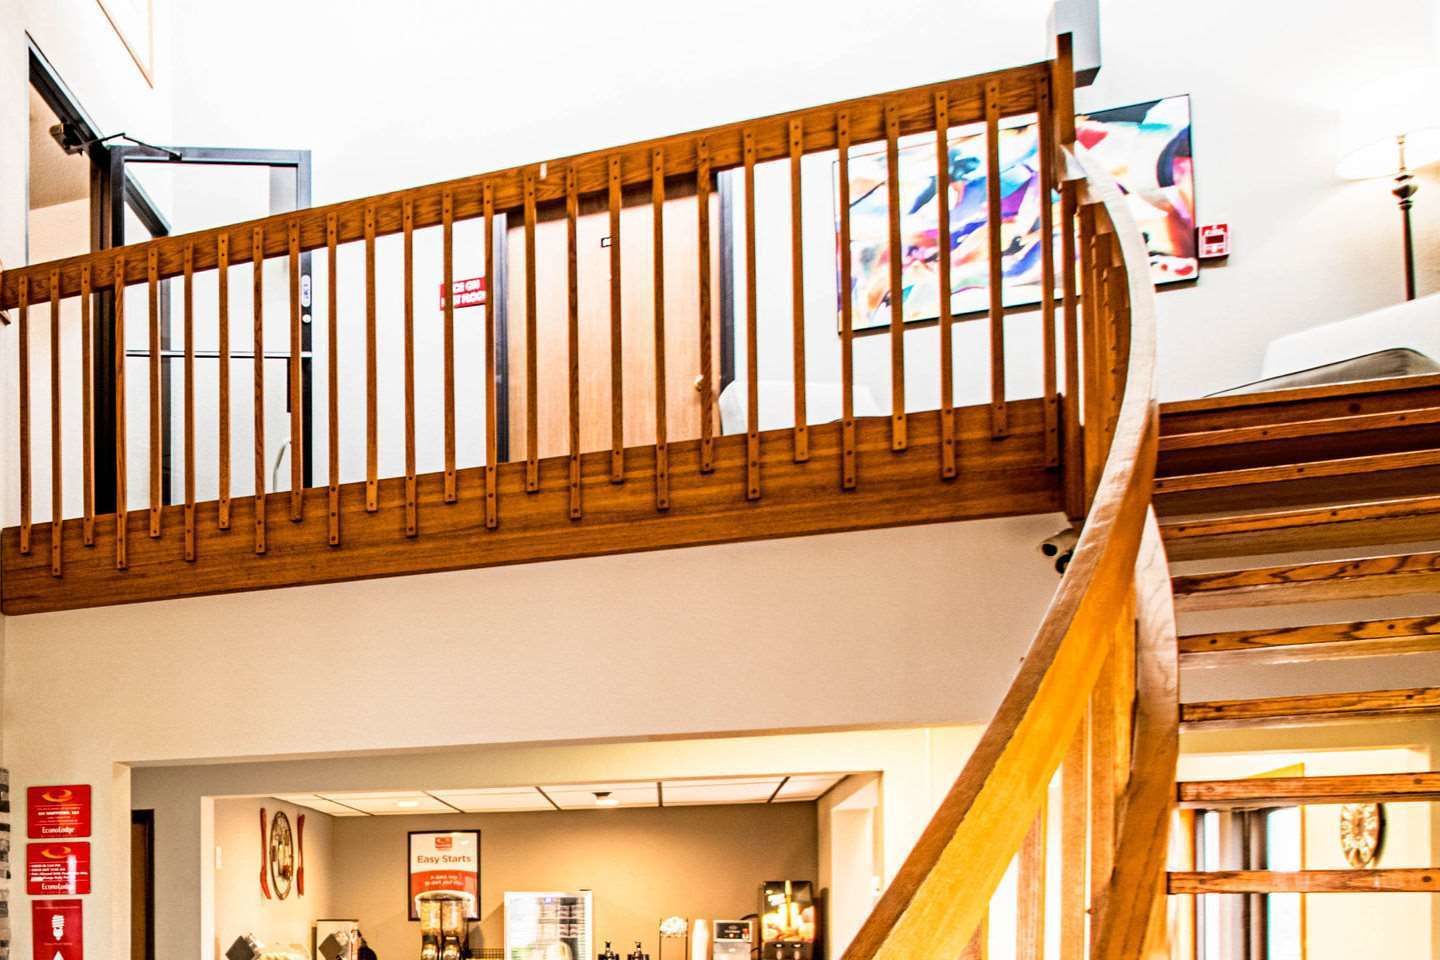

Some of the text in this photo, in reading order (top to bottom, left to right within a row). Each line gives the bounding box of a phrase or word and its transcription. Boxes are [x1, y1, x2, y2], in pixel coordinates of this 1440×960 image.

[462, 290, 487, 304] FLOO
[417, 855, 472, 864] Easy Starts
